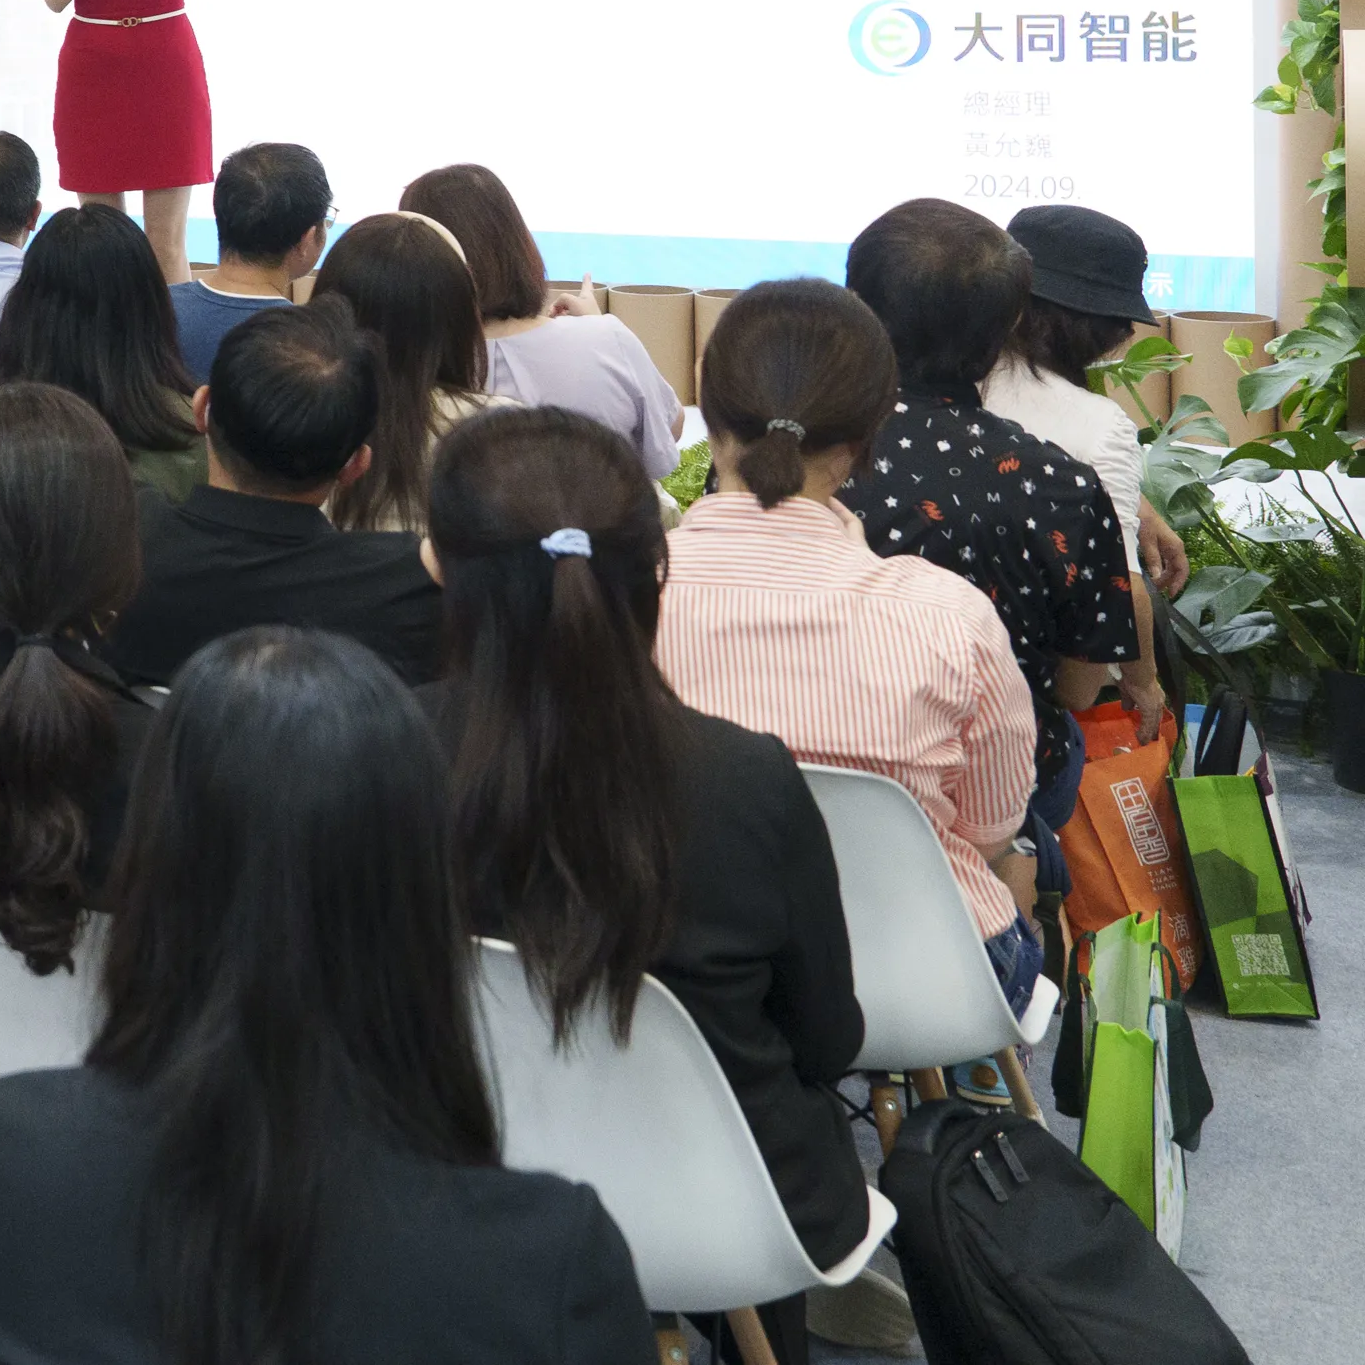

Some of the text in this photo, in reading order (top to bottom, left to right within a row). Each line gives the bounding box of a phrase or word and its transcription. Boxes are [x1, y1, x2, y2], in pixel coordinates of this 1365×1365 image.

[953, 11, 1198, 64] 大同智能
[963, 90, 1053, 118] 總經理
[963, 174, 1082, 201] 2024.09.
